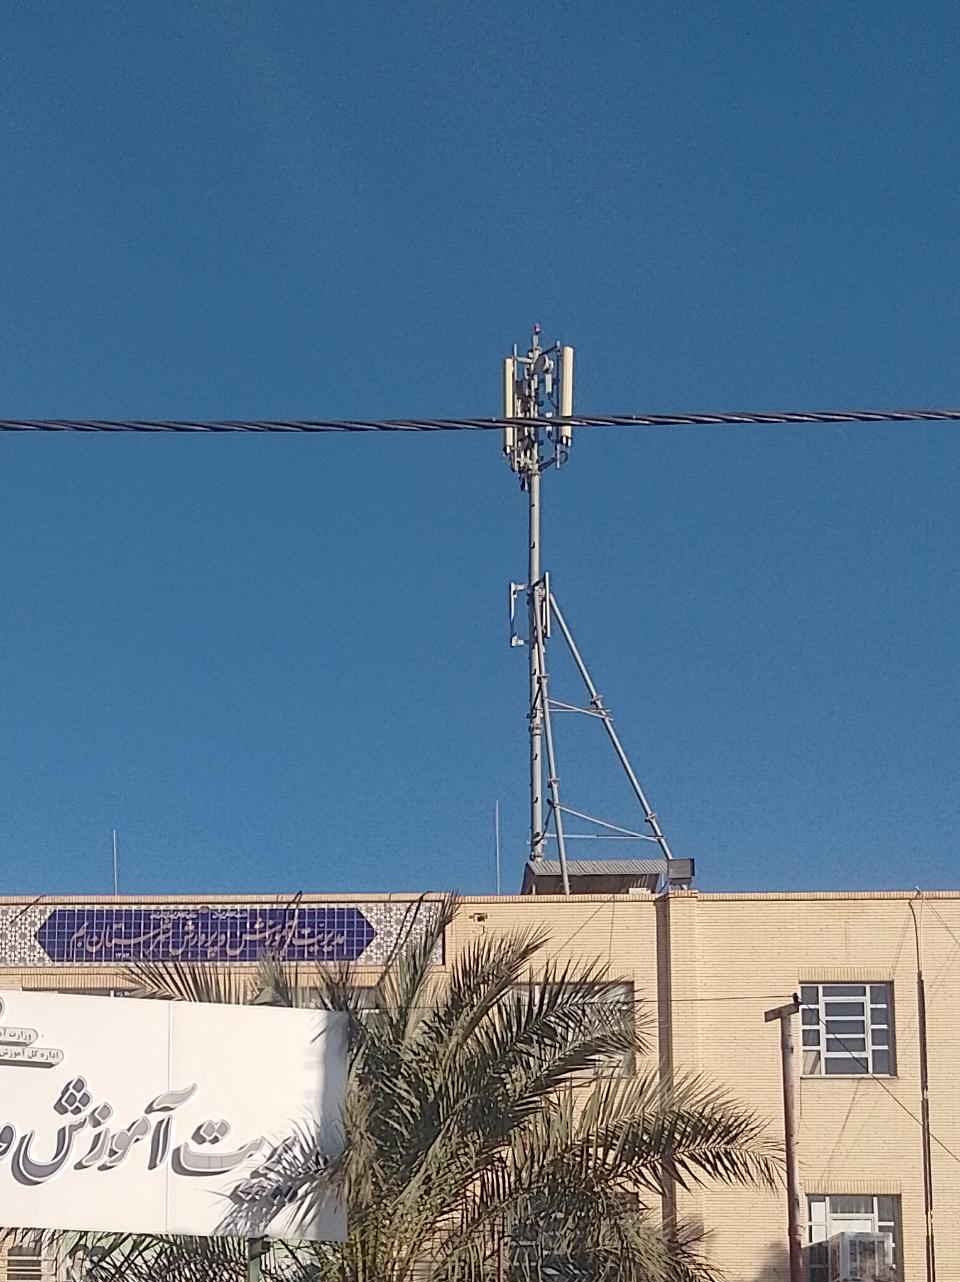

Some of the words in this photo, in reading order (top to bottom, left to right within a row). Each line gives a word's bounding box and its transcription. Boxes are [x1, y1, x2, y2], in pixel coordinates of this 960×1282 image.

[69, 921, 89, 960] بم
[86, 918, 172, 953] شهرستان
[169, 920, 218, 960] پرورش
[292, 922, 346, 952] مدیریت
[9, 1031, 32, 1041] وزارت
[0, 1047, 25, 1059] آموزش
[40, 1049, 59, 1061] اداره
[11, 1075, 197, 1186] آموزش
